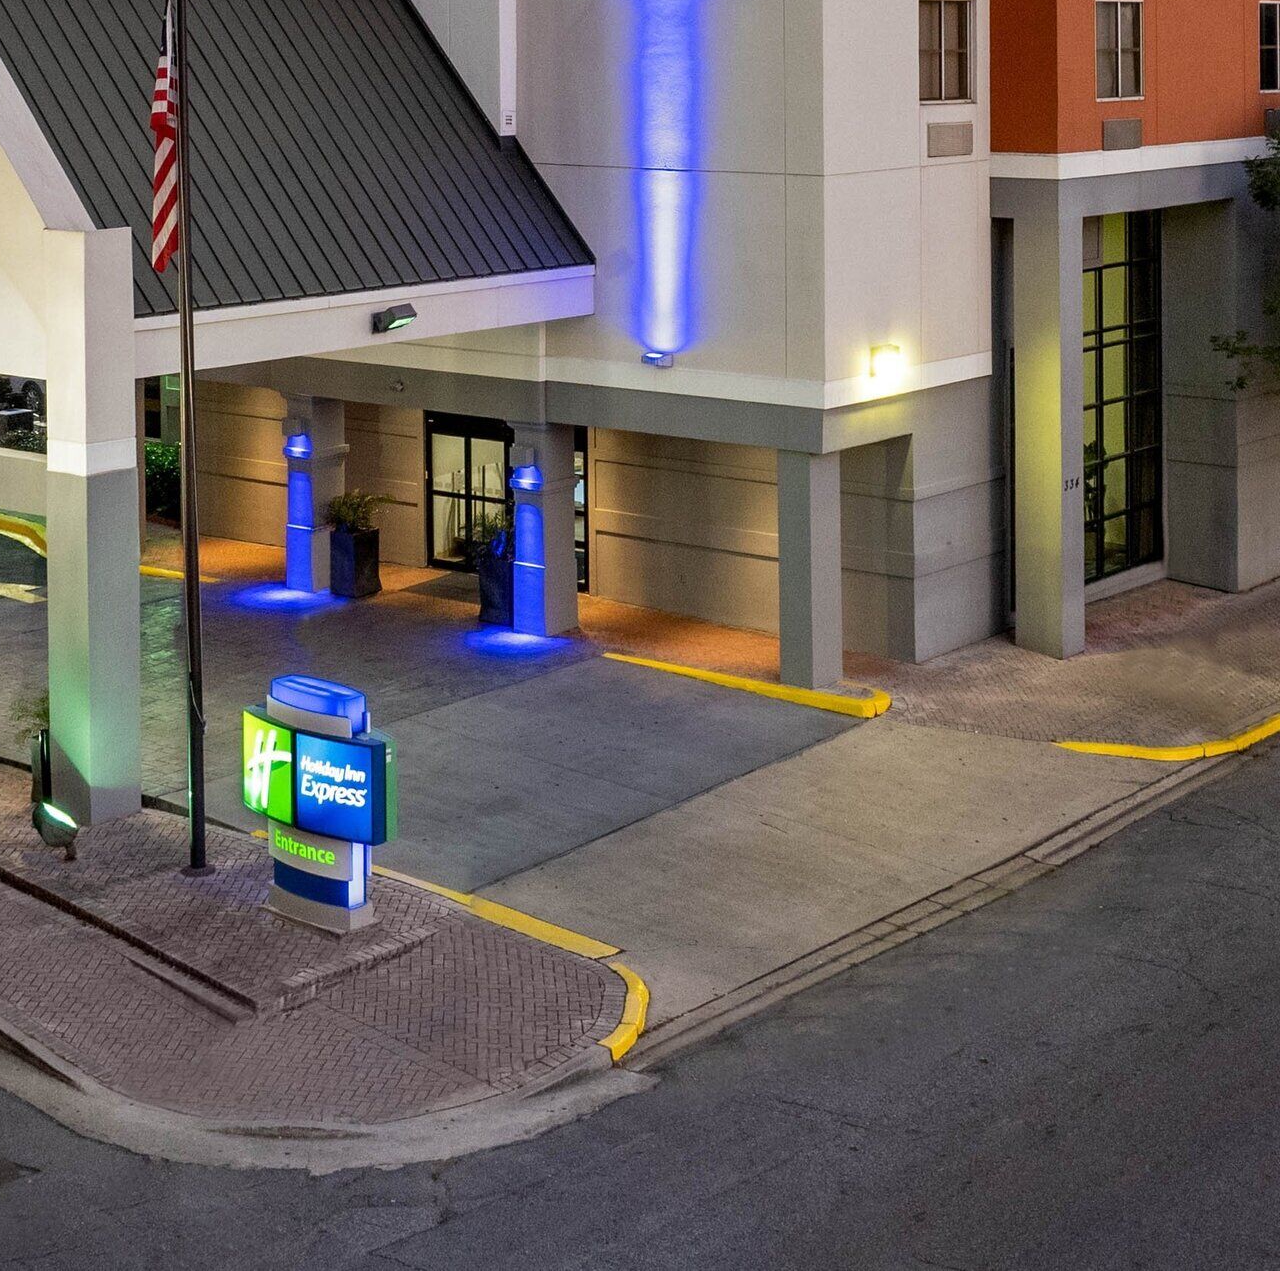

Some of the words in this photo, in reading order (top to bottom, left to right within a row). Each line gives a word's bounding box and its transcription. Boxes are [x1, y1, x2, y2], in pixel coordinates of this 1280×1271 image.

[301, 755, 344, 782] Holiday
[344, 764, 366, 783] Inn
[301, 774, 367, 807] Express
[275, 829, 335, 865] Entrance
